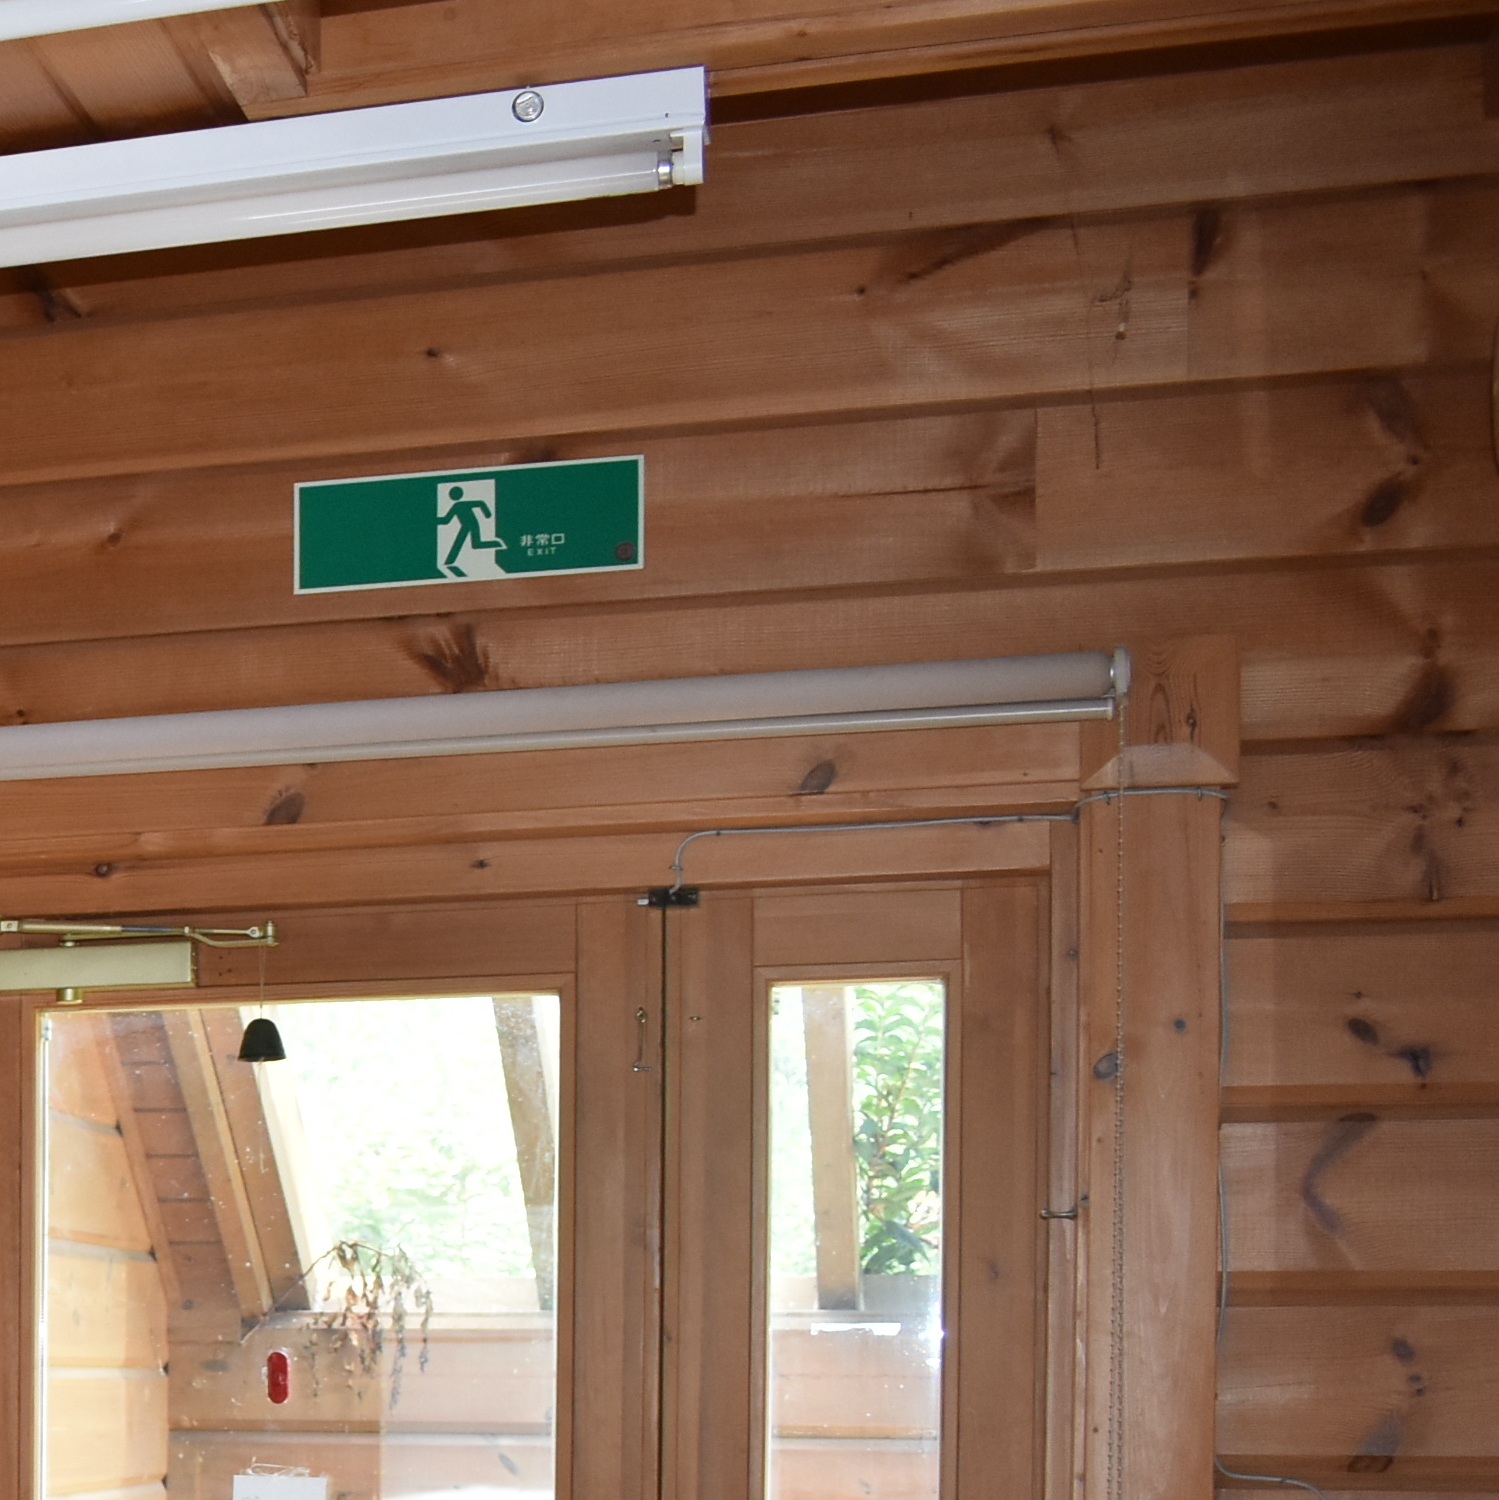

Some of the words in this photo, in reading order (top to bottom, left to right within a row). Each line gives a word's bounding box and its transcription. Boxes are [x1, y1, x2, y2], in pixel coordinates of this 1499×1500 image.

[520, 533, 564, 546] 非常口
[527, 547, 556, 556] EXIT
